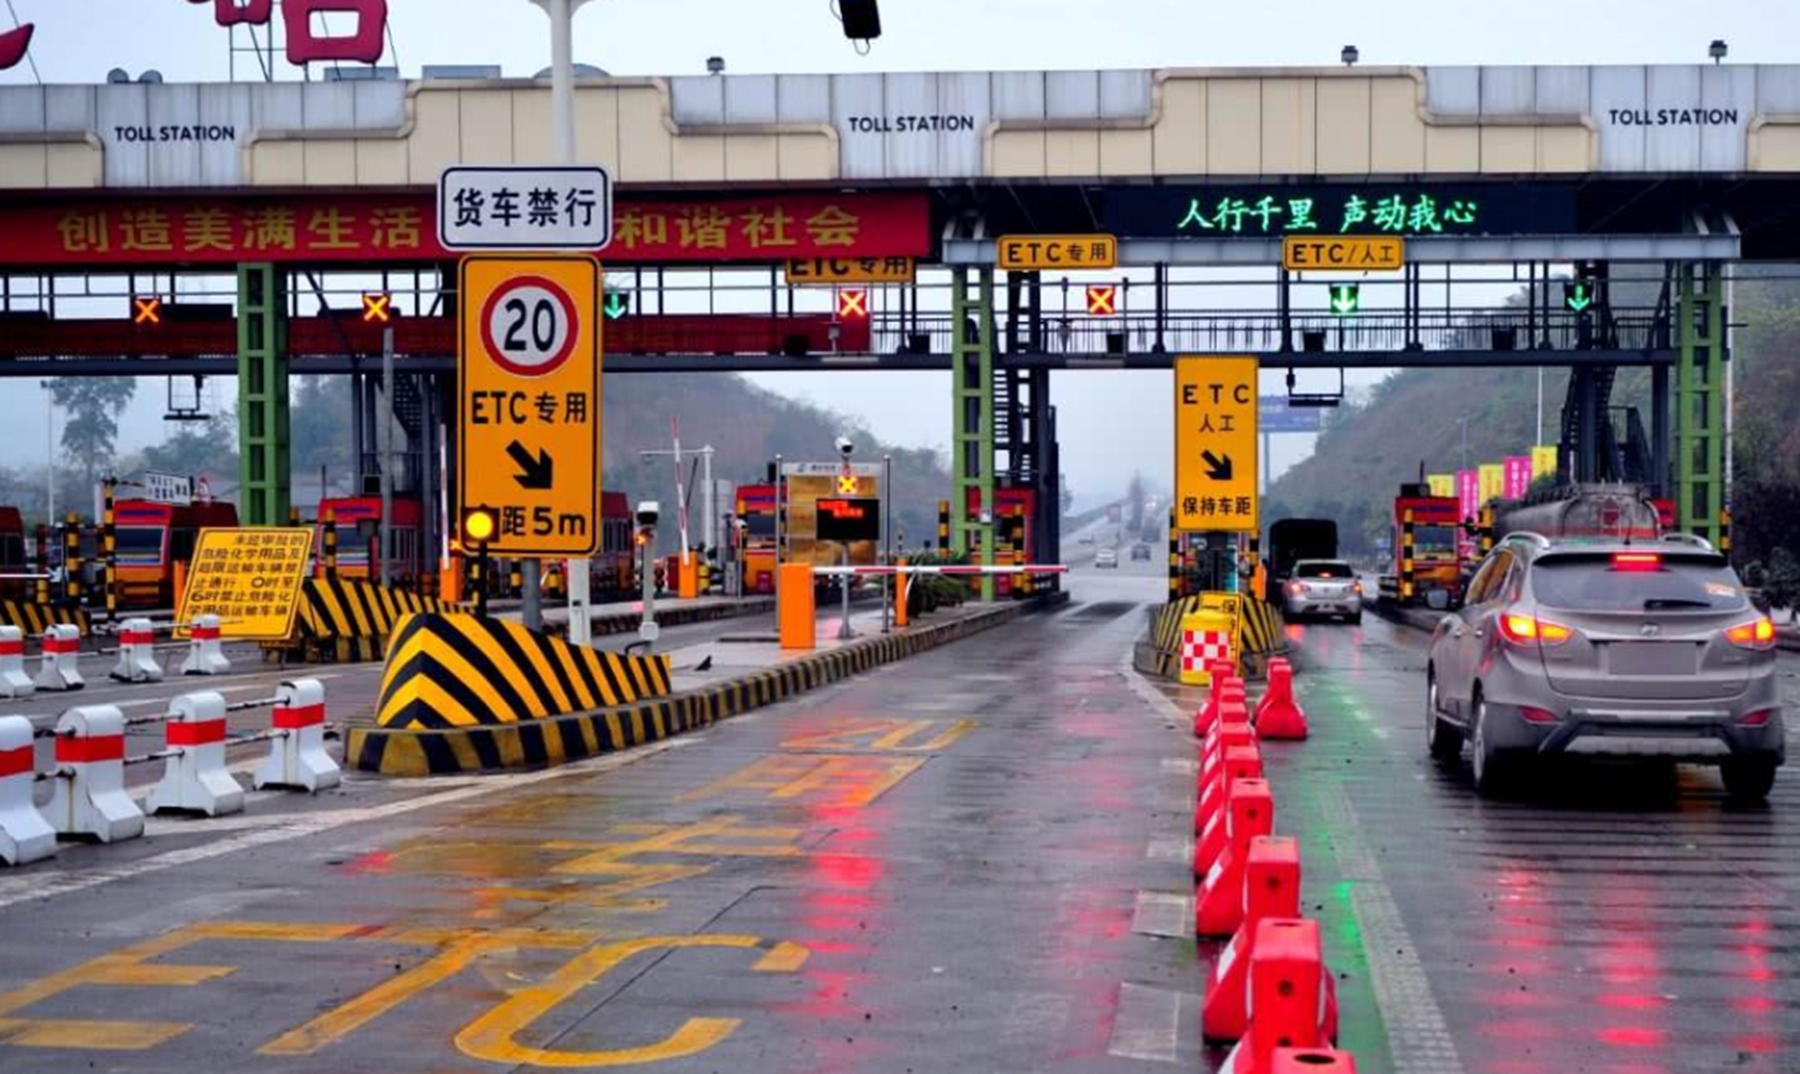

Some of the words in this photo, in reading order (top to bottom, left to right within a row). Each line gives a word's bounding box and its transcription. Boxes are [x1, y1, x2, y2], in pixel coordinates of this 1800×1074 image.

[848, 117, 892, 132] TOLL
[896, 115, 974, 132] STATION
[1608, 109, 1653, 125] TOLL
[1657, 109, 1737, 125] STATION
[114, 126, 156, 142] TOLL
[159, 125, 235, 141] STATION
[453, 187, 597, 228] 货车禁行
[1177, 195, 1317, 232] 人行千里
[1340, 194, 1477, 233] 声动我心
[57, 206, 422, 253] 创造美满生活
[614, 206, 860, 249] 和谐社会
[1008, 242, 1106, 263] ETC专用
[1292, 243, 1395, 264] ETC/人工
[504, 299, 556, 351] 20
[1182, 384, 1250, 404] ETC
[471, 391, 587, 424] ETC专用
[1198, 414, 1235, 433] 人工
[1182, 497, 1251, 516] 保持车距
[0, 922, 811, 1066] ETC
